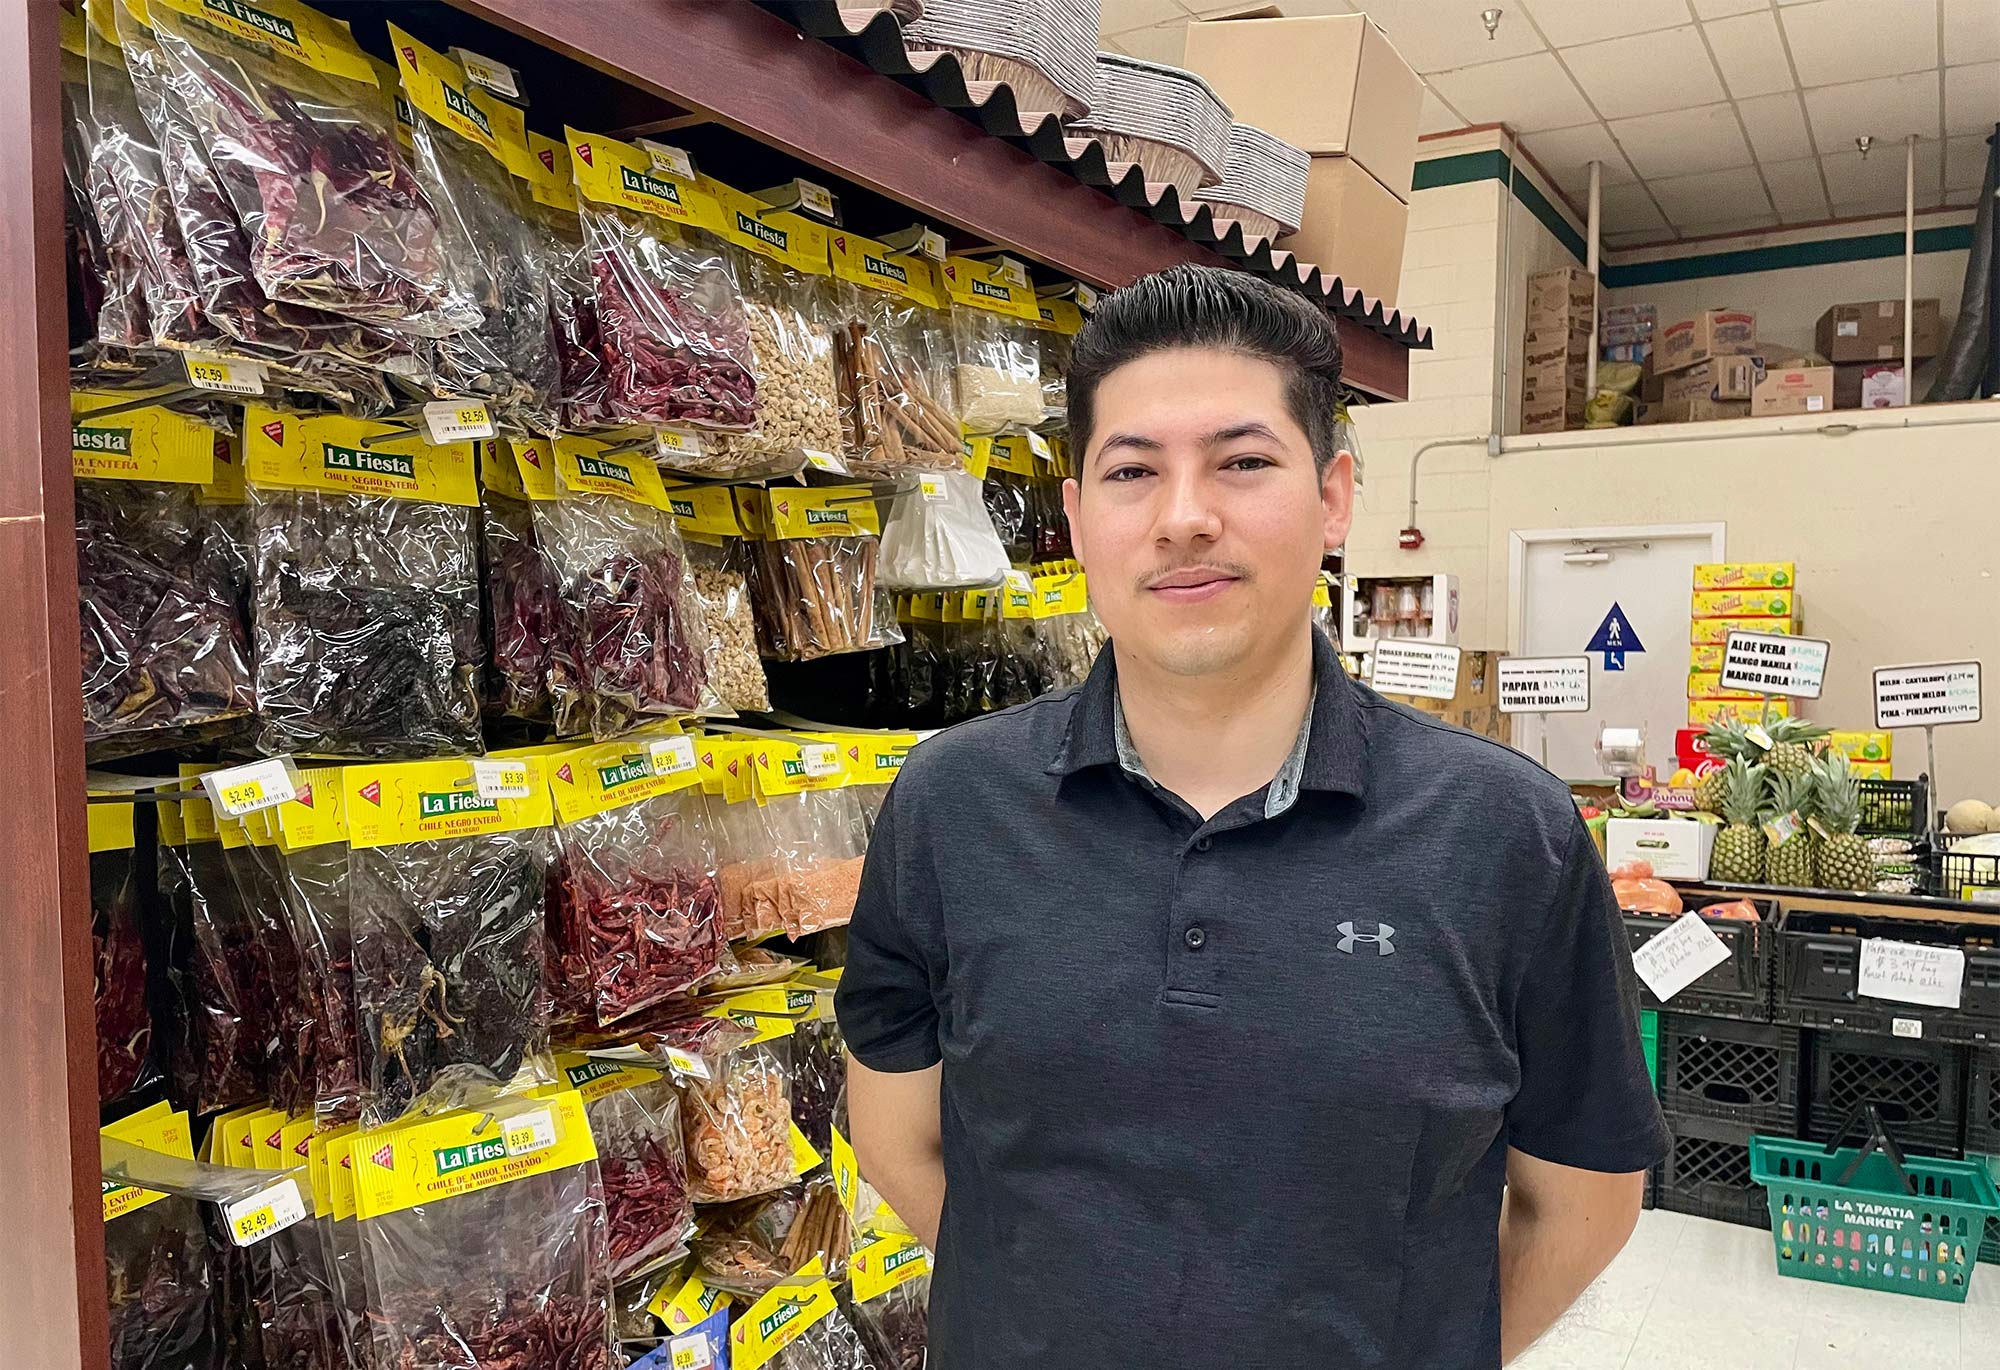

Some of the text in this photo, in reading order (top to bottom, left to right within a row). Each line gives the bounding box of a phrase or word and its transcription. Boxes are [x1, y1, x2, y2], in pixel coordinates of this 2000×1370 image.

[233, 1, 294, 40] Fiesta
[445, 87, 491, 134] La Fiesta
[623, 170, 678, 201] La Fiesta
[739, 215, 753, 232] La
[755, 221, 786, 248] Fiesta
[866, 257, 906, 281] La Fiesta
[973, 281, 1009, 299] La Fiesta
[195, 366, 223, 382] $2.59
[462, 409, 485, 423] $2.59
[72, 428, 127, 450] iesta
[89, 458, 139, 470] ENTERA
[327, 448, 412, 474] La Fiesta
[579, 458, 632, 482] La Fiesta
[324, 471, 419, 492] CHILE NEGRO ENTERO
[808, 511, 820, 522] La
[1731, 640, 1786, 656] ALOE VERA
[1729, 656, 1792, 671] MANGO MANILA
[1502, 681, 1540, 692] PAPAYA
[1726, 670, 1789, 687] MANGO BOLA
[1502, 696, 1537, 705] TOMATE
[1538, 695, 1560, 704] BOLA
[1880, 690, 1946, 703] HONEYDEW MELON
[1906, 705, 1946, 717] PINEAPPLE
[784, 761, 795, 774] La
[876, 755, 905, 767] La Fies
[505, 772, 525, 785] $3.39
[602, 761, 653, 786] La Fiesta
[228, 786, 256, 804] $2.49
[423, 793, 495, 814] La Fiesta
[419, 815, 502, 831] CHILE NEGRO ENTERO
[569, 1063, 619, 1084] La Fiesta
[510, 1132, 530, 1146] $3.39
[439, 1142, 505, 1171] La Fies
[427, 1156, 542, 1192] CHILE DE ARBOL TOSTADO
[110, 1186, 143, 1208] ENTERO
[1835, 1200, 1915, 1220] LA TAPATIA
[241, 1213, 267, 1235] $2.49
[1844, 1213, 1904, 1231] MARKET
[886, 1246, 924, 1271] La Fiesta
[761, 1305, 799, 1337] La Fiesta
